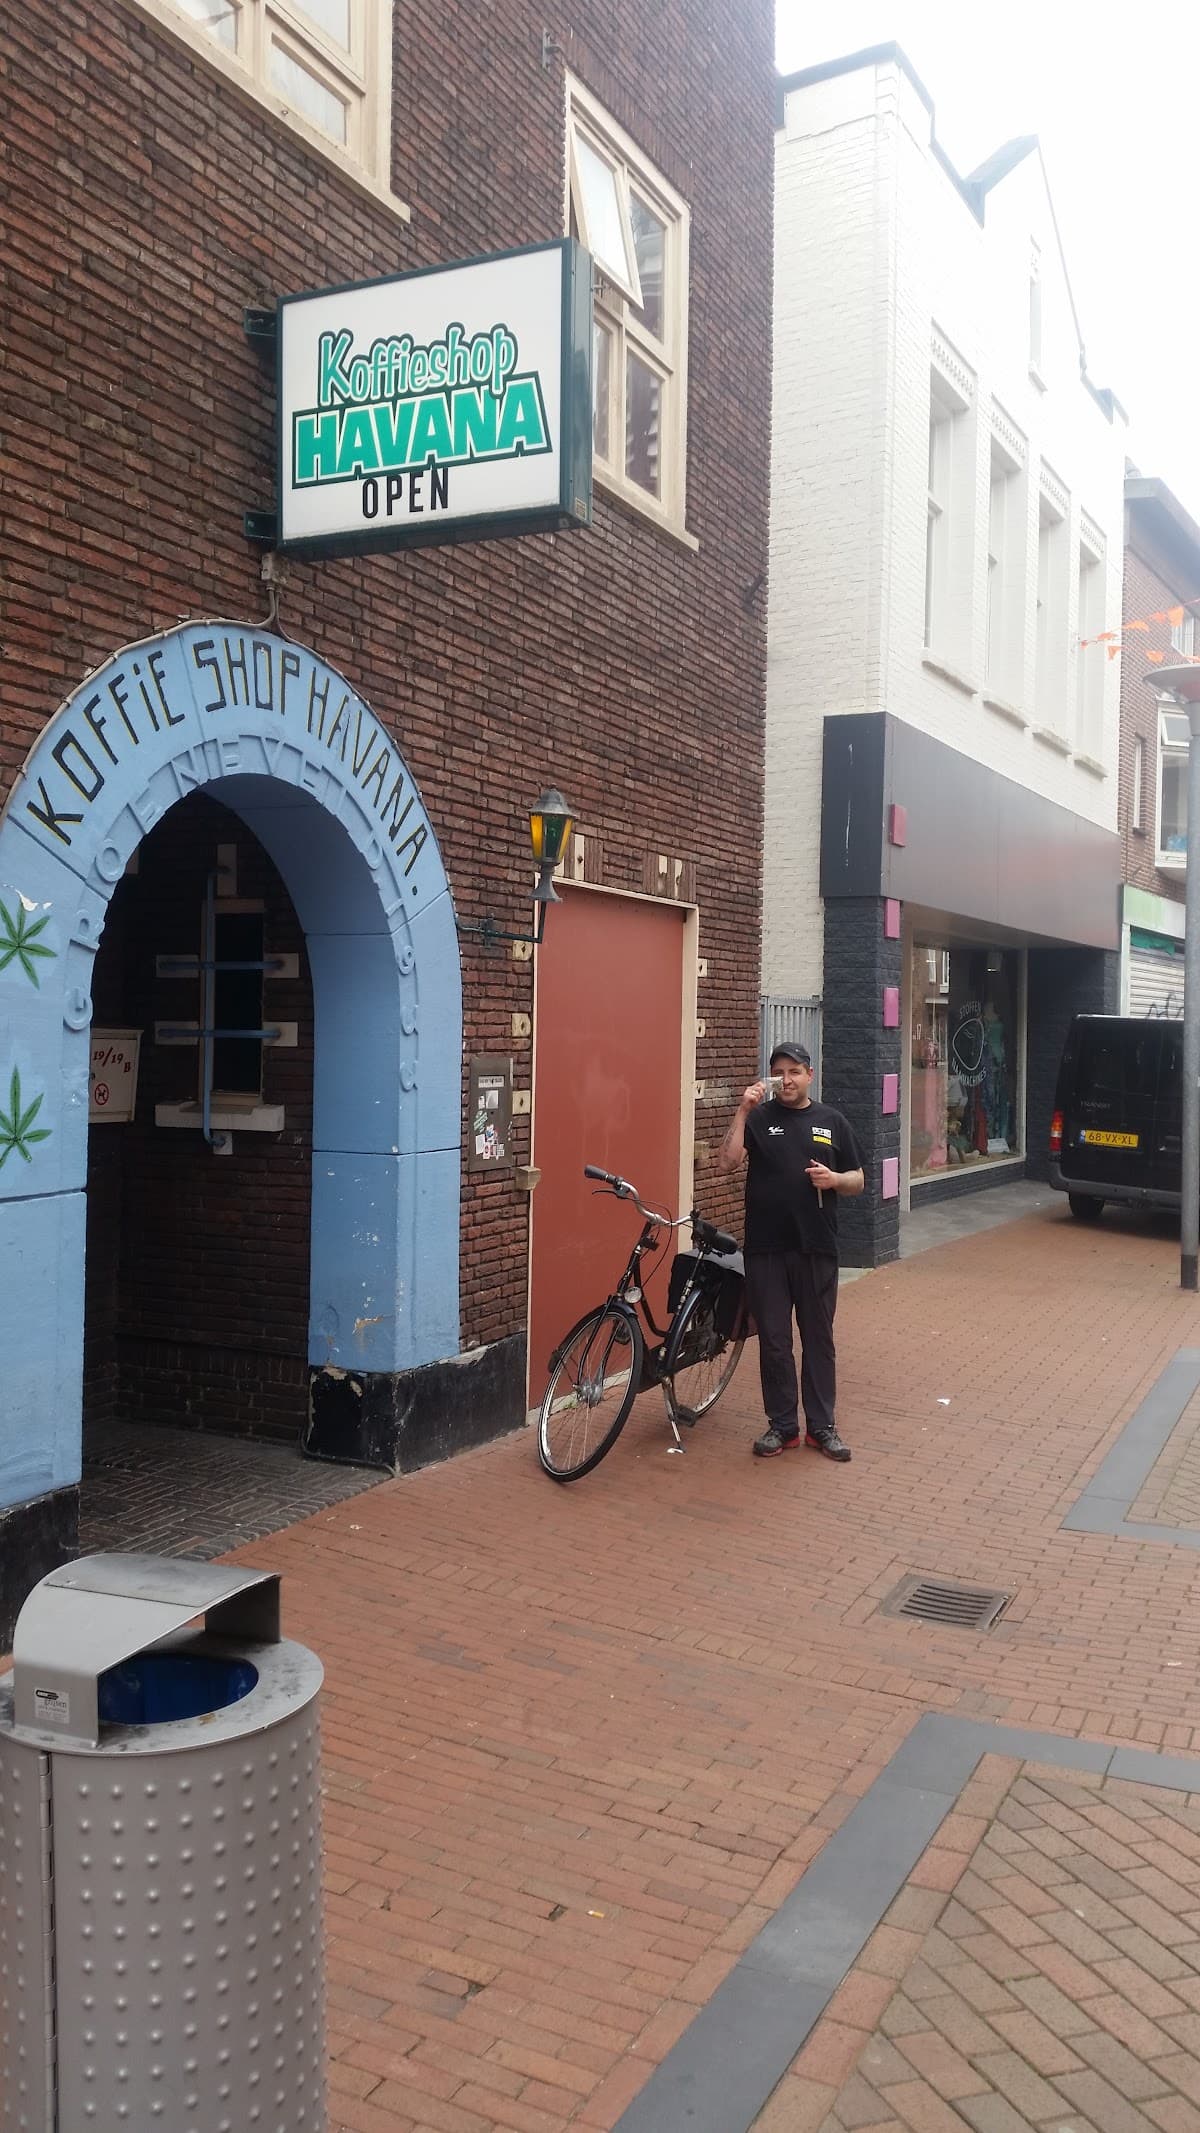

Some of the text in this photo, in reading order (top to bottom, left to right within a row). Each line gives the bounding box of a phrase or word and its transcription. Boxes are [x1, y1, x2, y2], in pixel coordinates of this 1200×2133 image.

[319, 322, 518, 406] Koffieshop
[294, 373, 551, 486] HAVANA
[362, 467, 449, 519] OPEN
[193, 638, 301, 715] SHOP
[1088, 1132, 1134, 1145] 68-VX-XL
